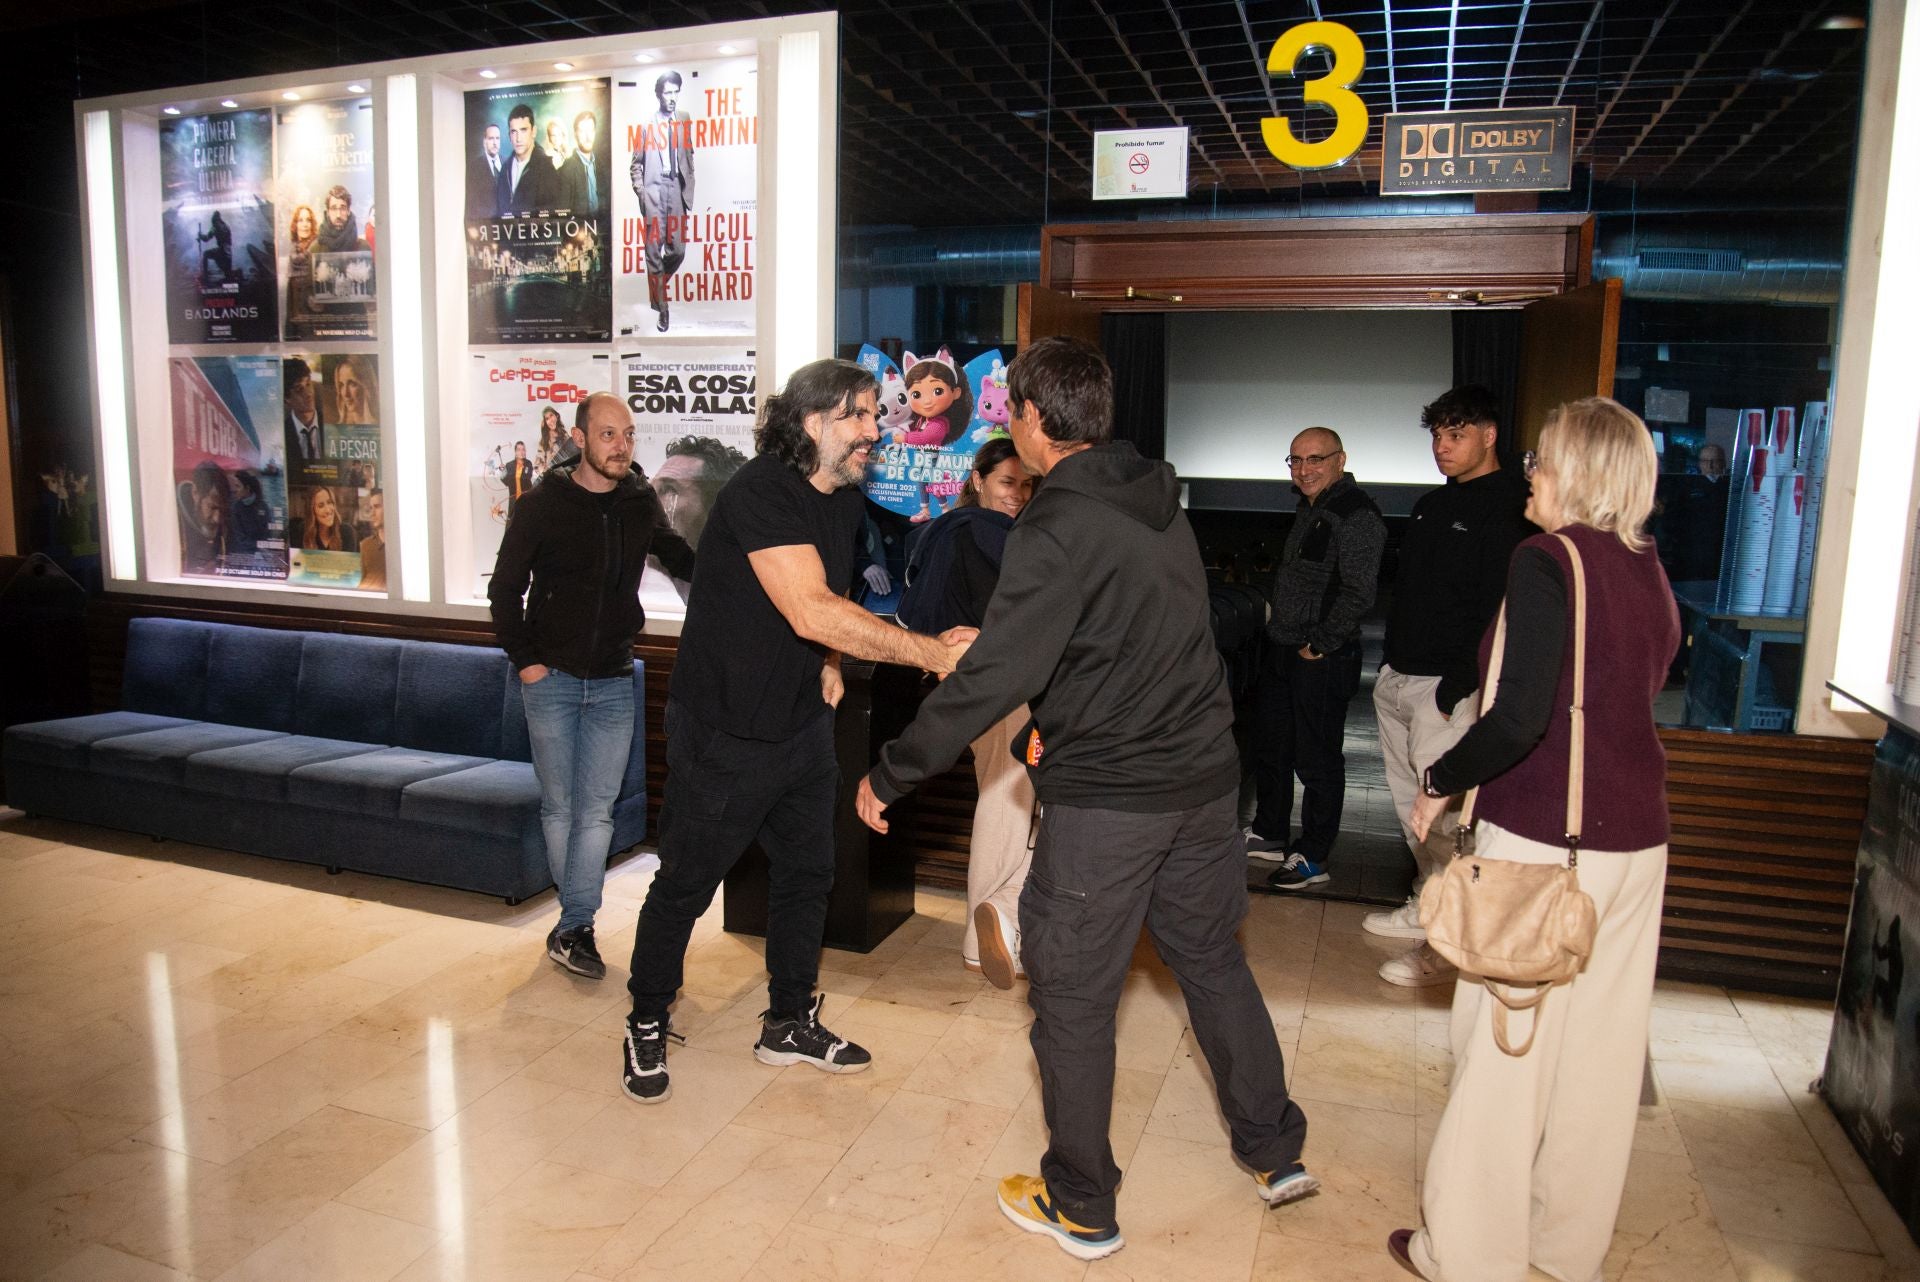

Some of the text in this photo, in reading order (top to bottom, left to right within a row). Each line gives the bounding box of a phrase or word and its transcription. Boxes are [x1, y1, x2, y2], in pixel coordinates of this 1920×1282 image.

[705, 87, 743, 117] THE
[1261, 21, 1370, 169] 3
[194, 119, 236, 144] PRIMERA
[1471, 129, 1543, 148] DOLBY
[194, 142, 237, 169] CACERÍA
[1400, 158, 1552, 178] DIGITAL
[623, 206, 757, 246] UNA PELÍCUL
[623, 247, 645, 274] DE
[184, 306, 259, 320] BADLANDS
[628, 363, 682, 372] BENEDICT
[628, 374, 684, 394] ESA
[627, 394, 686, 414] CON
[329, 440, 378, 459] A PESAR
[914, 451, 934, 468] DE
[886, 465, 966, 483] DE GABBY
[867, 481, 917, 492] OCTUBRE 2025
[868, 489, 915, 498] EXCLUSIVAMENTE
